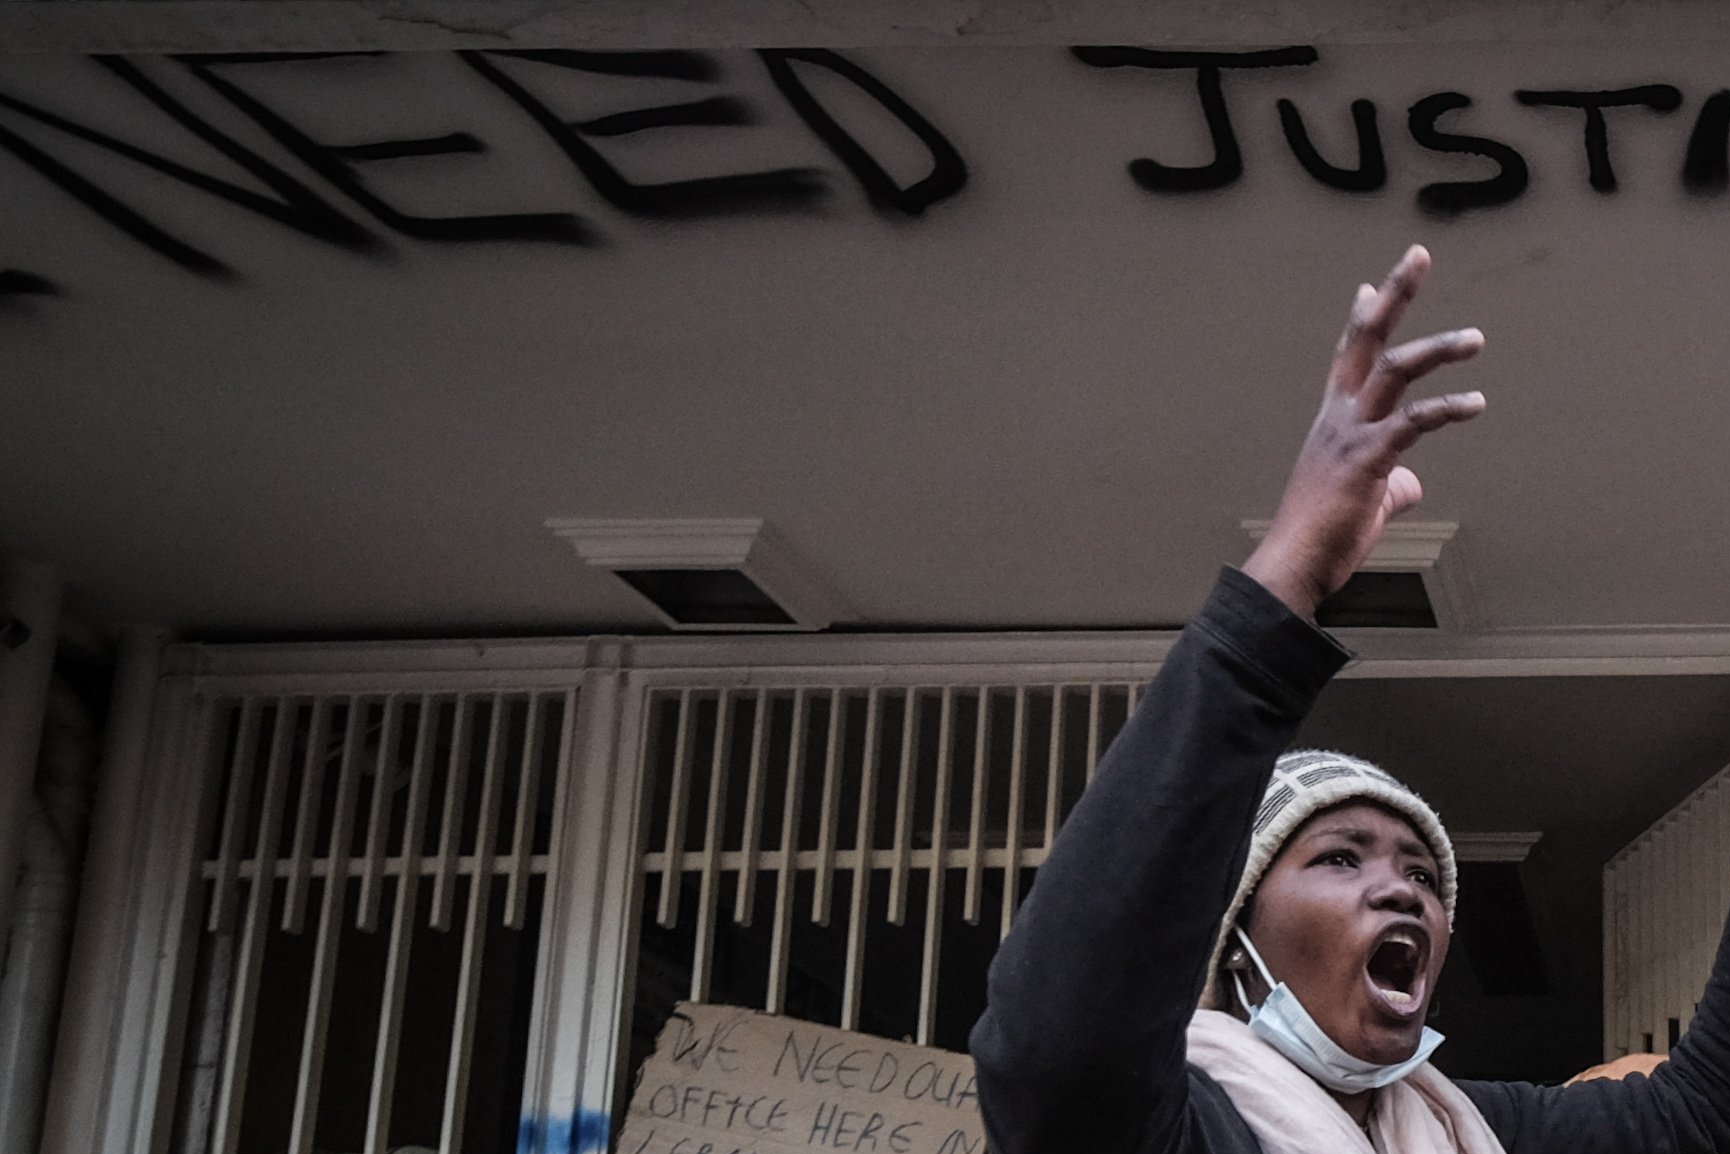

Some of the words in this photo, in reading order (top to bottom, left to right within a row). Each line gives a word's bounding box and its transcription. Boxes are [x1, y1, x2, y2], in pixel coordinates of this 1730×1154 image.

[0, 48, 970, 282] NEED
[671, 1012, 752, 1075] WE
[773, 1030, 899, 1094] NEED
[648, 1084, 789, 1134] OFFICE
[807, 1102, 923, 1154] HERE
